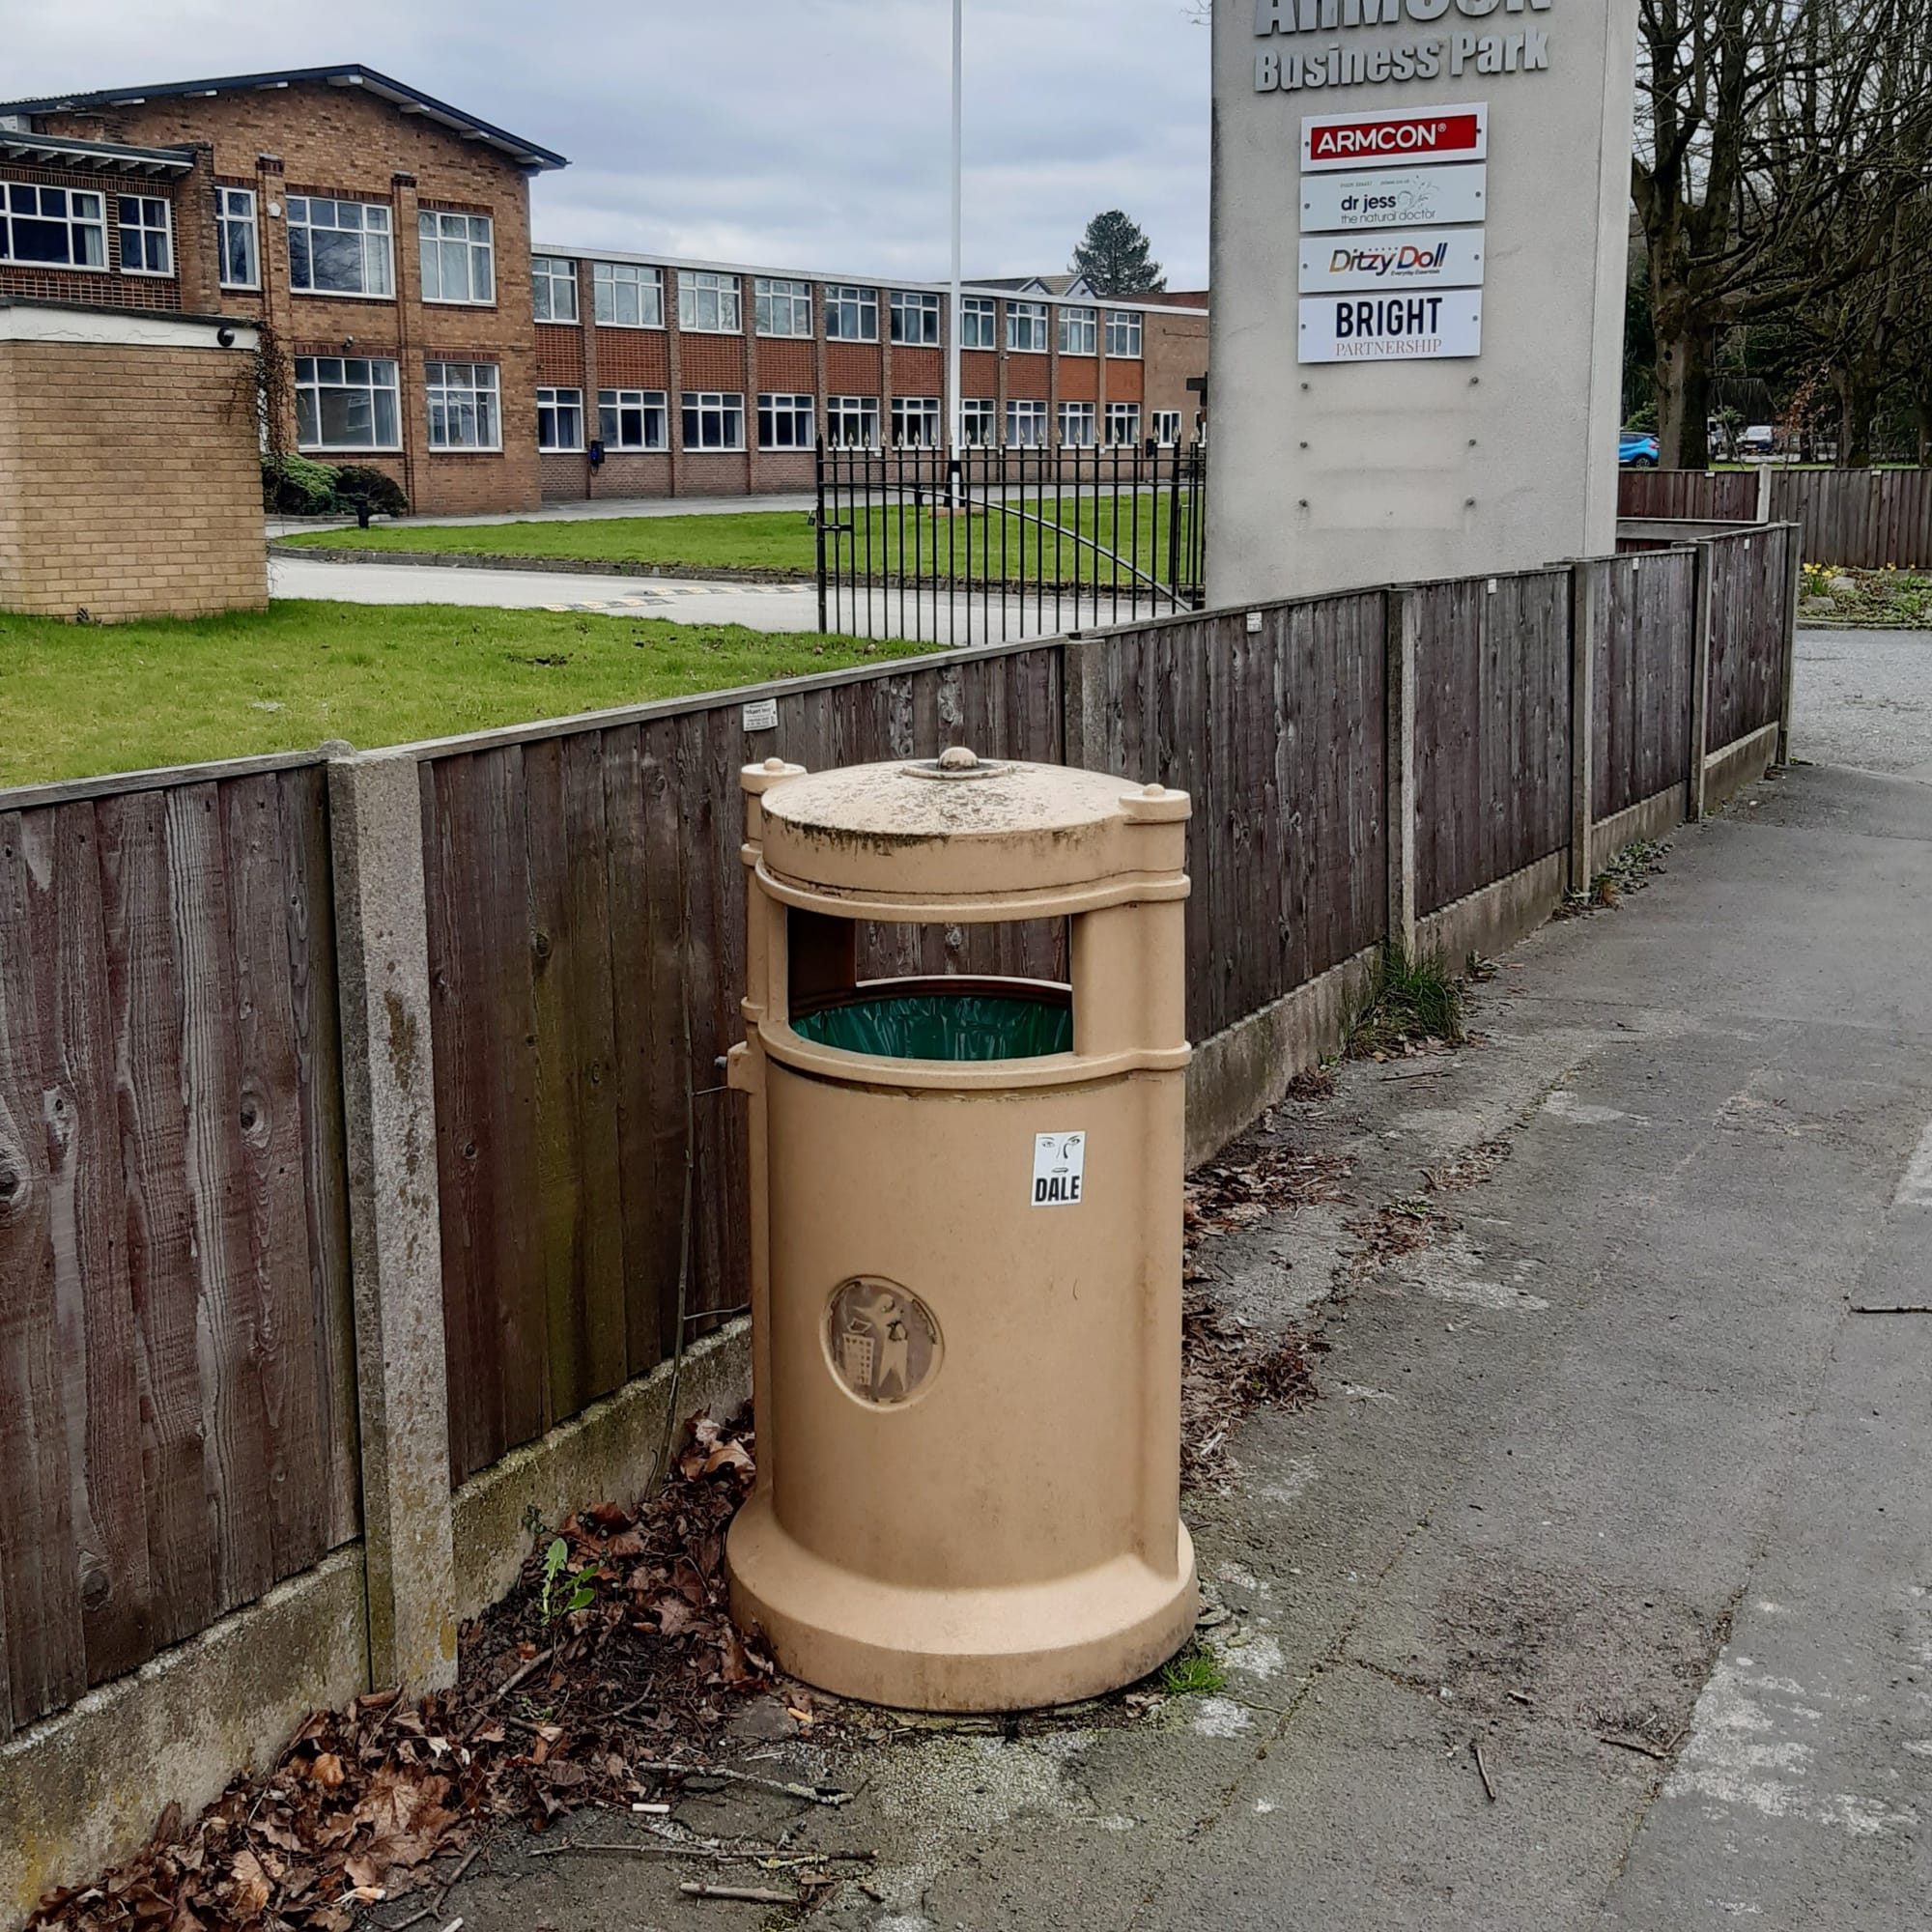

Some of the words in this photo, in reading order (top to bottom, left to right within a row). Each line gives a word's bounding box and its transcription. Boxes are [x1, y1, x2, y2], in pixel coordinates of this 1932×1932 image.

[1255, 43, 1441, 93] Business
[1451, 27, 1549, 77] Park
[1341, 195, 1360, 212] dr
[1362, 194, 1397, 213] jess
[1341, 213, 1358, 225] the
[1359, 210, 1397, 224] natural
[1398, 208, 1436, 221] doctor
[1329, 248, 1397, 277] Ditzy
[1397, 242, 1449, 270] Doll
[1336, 298, 1443, 338] BRIGHT
[1336, 338, 1442, 356] PARTNERSHIP
[1035, 1175, 1080, 1203] DALE
